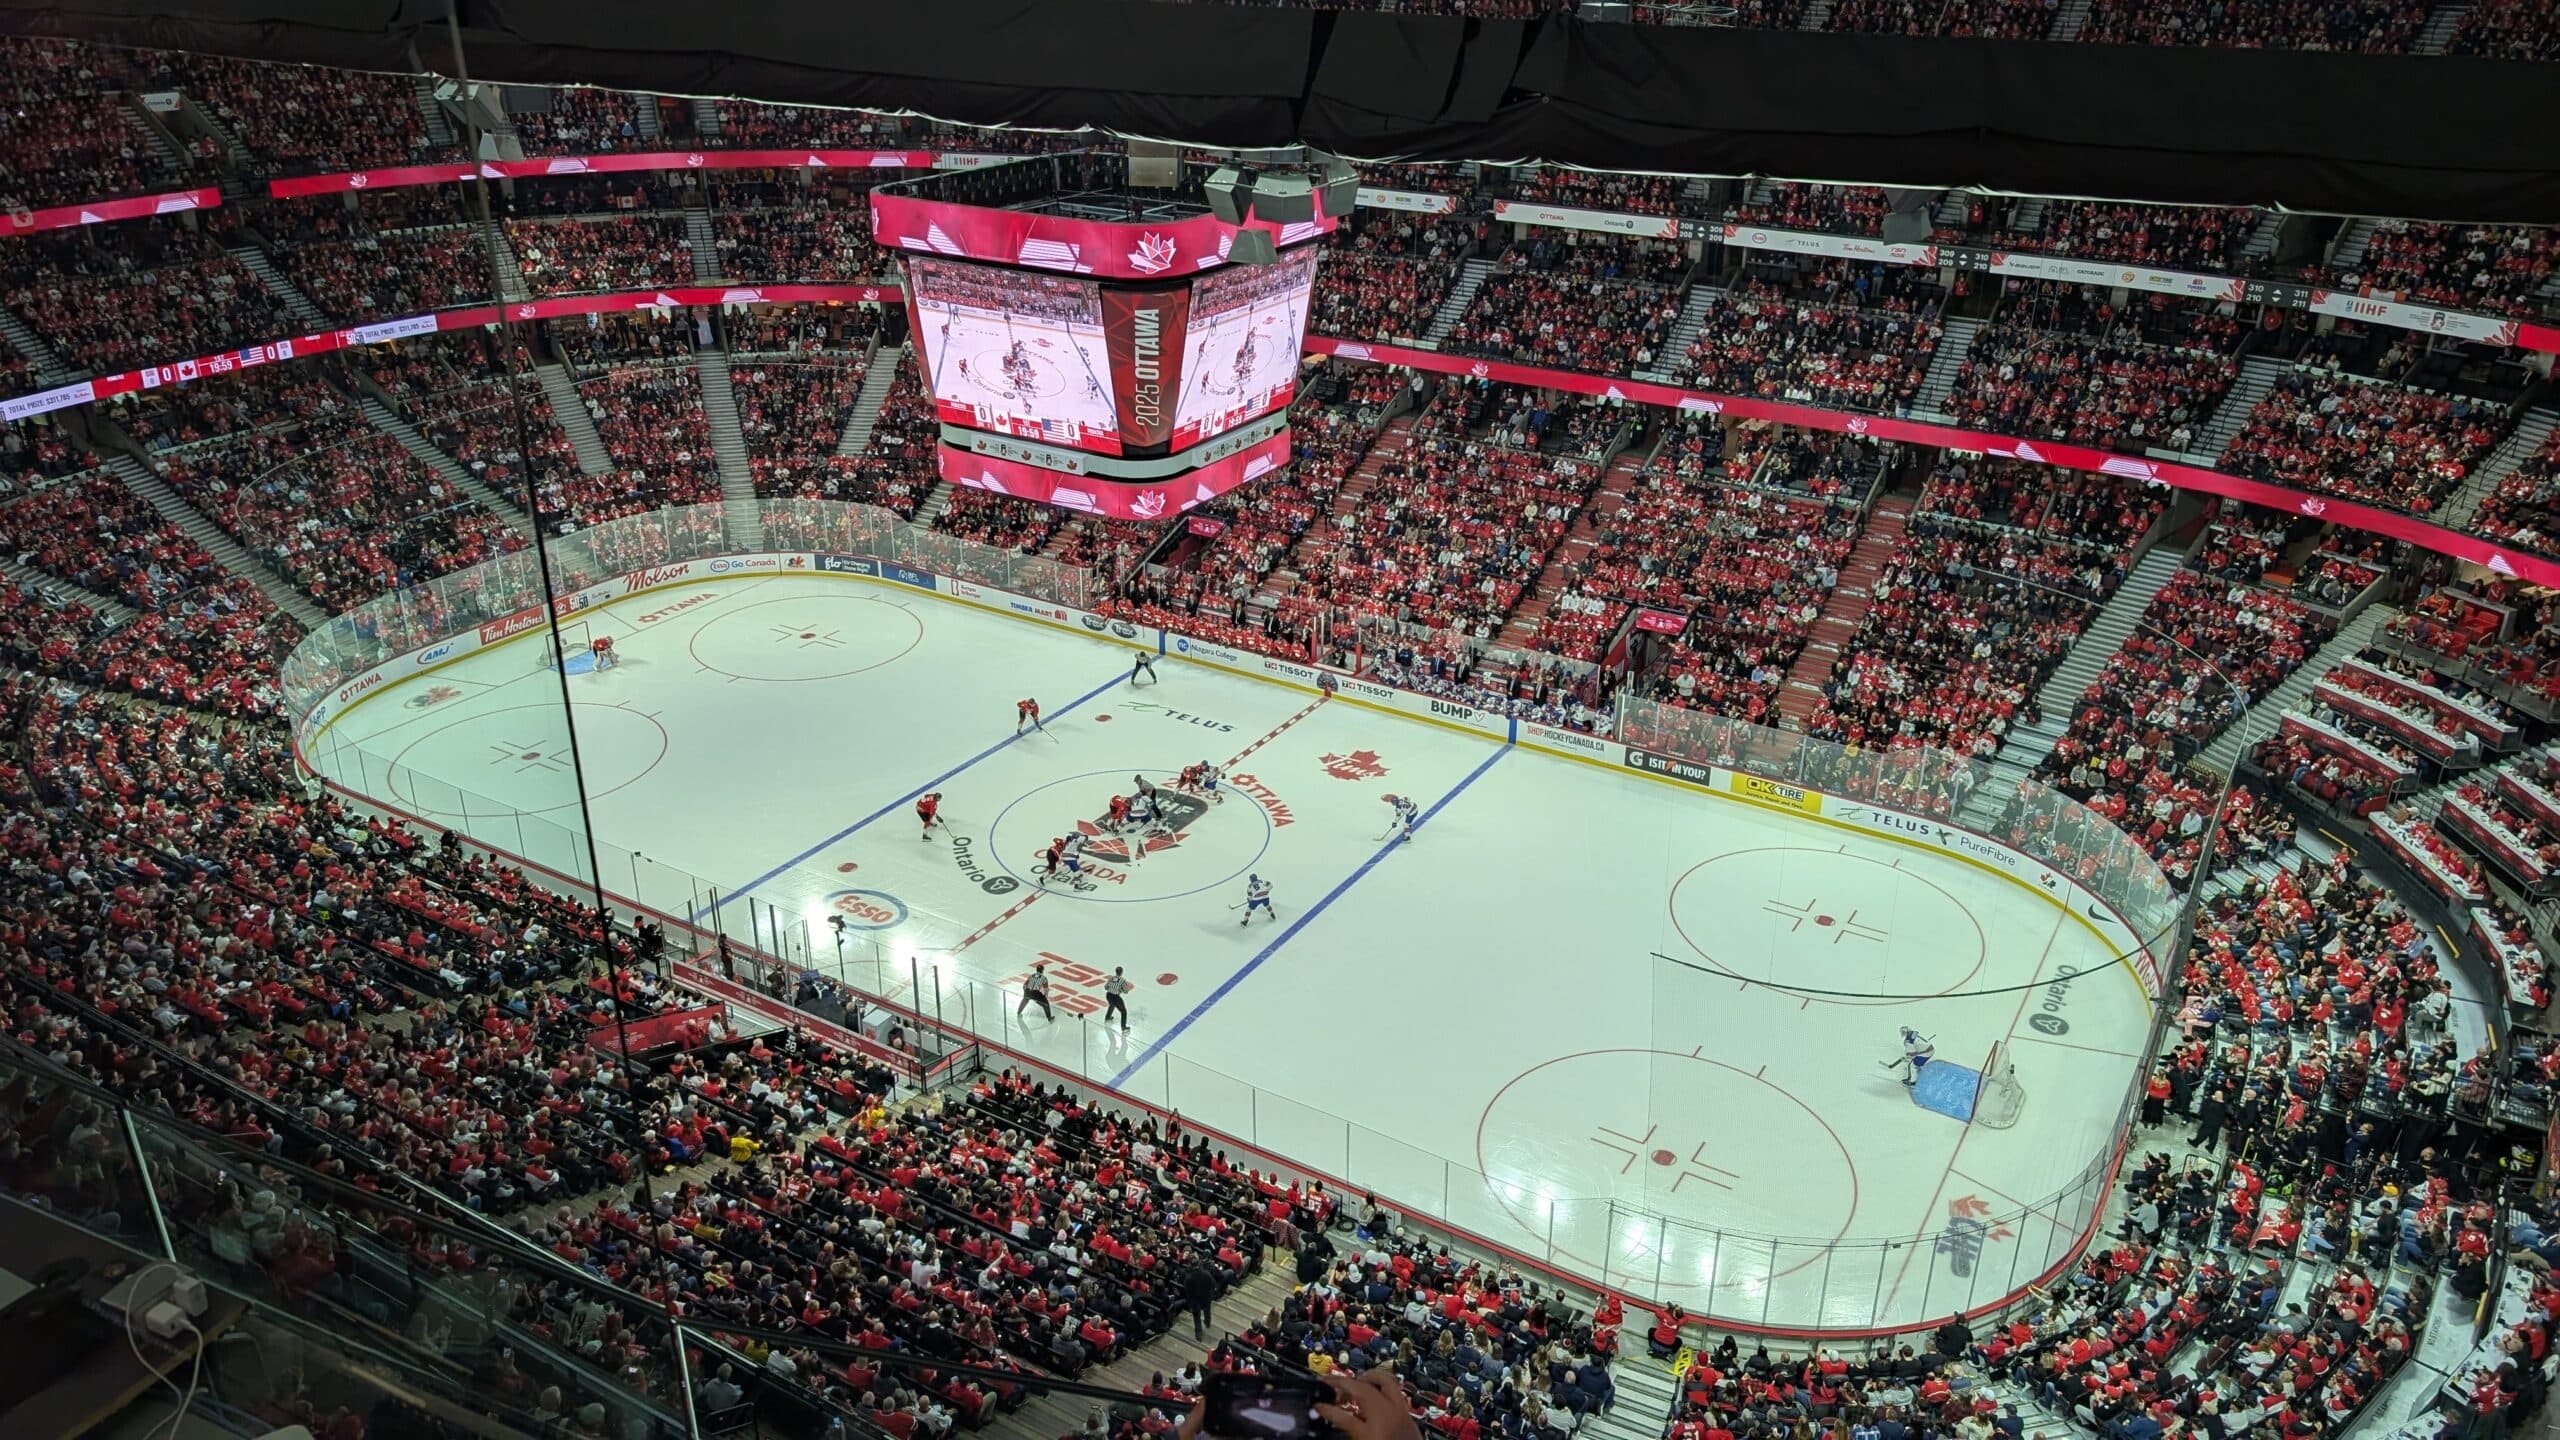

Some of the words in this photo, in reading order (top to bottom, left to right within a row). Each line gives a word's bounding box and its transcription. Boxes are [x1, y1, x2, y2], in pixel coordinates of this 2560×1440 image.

[1539, 213, 1565, 222] OTTAWA
[1604, 219, 1626, 229] Ontario
[1680, 222, 1694, 231] 308
[1709, 225, 1724, 234] 309
[1797, 240, 1820, 248] TELUS
[1940, 248, 1955, 258] 309
[1975, 252, 1989, 261] 310
[1938, 257, 1954, 266] 209
[1973, 261, 1988, 270] 210
[2248, 284, 2265, 293] 310
[2294, 290, 2309, 298] 311
[2246, 293, 2262, 302] 210
[2292, 299, 2307, 308] 211
[2354, 302, 2387, 317] IIHF
[1134, 308, 1160, 380] OTTAWA
[209, 360, 233, 374] 19:59
[8, 404, 26, 414] TOTAL
[1135, 384, 1160, 427] 2025
[731, 560, 744, 568] Go
[745, 558, 776, 567] Canada
[824, 556, 842, 570] flo
[622, 564, 689, 593] Molson
[638, 592, 719, 623] OTTAWA
[1010, 602, 1033, 612] TIMBER
[1034, 607, 1053, 618] MART
[481, 626, 502, 643] Tim
[503, 614, 543, 635] Hortons
[1085, 619, 1105, 630] Trex
[1114, 626, 1134, 637] Trex
[424, 646, 450, 661] AMJ
[1191, 643, 1215, 656] Niagara
[1215, 650, 1238, 662] College
[1278, 664, 1314, 680] TISSOT
[340, 672, 383, 703] OTTAWA
[1356, 683, 1394, 699] TISSOT
[1430, 700, 1473, 720] BUMP
[1164, 709, 1236, 733] TELUS
[1527, 725, 1605, 752] SHOP.HOCKEYCANADA.CA
[1682, 767, 1706, 780] YOU?
[1747, 778, 1772, 793] OK
[1778, 788, 1803, 801] TIRE
[1230, 773, 1295, 828] OTTAWA
[1872, 812, 1930, 835] TELUS
[1960, 836, 2016, 867] PureFibre
[952, 836, 986, 883] Ontario
[2043, 964, 2078, 1013] Ontario
